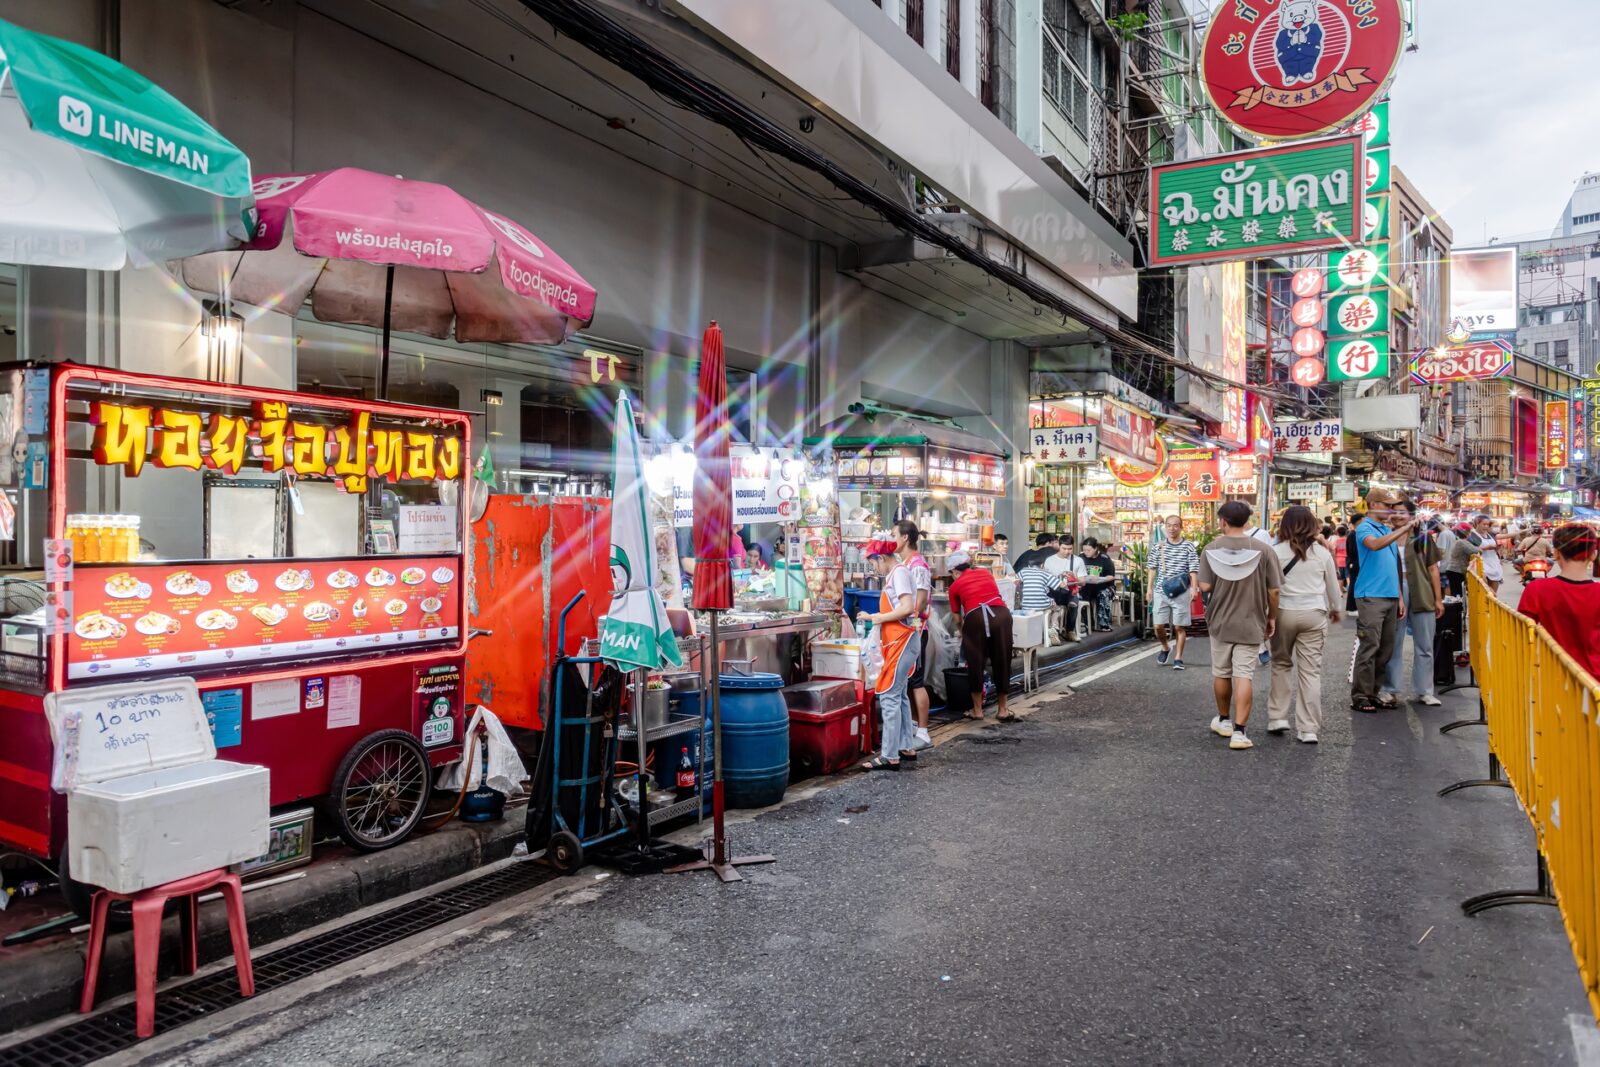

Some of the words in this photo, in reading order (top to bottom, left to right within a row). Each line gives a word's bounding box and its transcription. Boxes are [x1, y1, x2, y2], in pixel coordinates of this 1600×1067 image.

[156, 136, 208, 175] MAN
[1163, 161, 1349, 227] ฉ.มั่นคง
[335, 227, 453, 259] พร้อมส่งสุดใจ
[510, 260, 578, 307] foodpanda
[1466, 314, 1495, 325] AYS
[601, 629, 640, 651] MAN
[434, 722, 448, 732] 100
